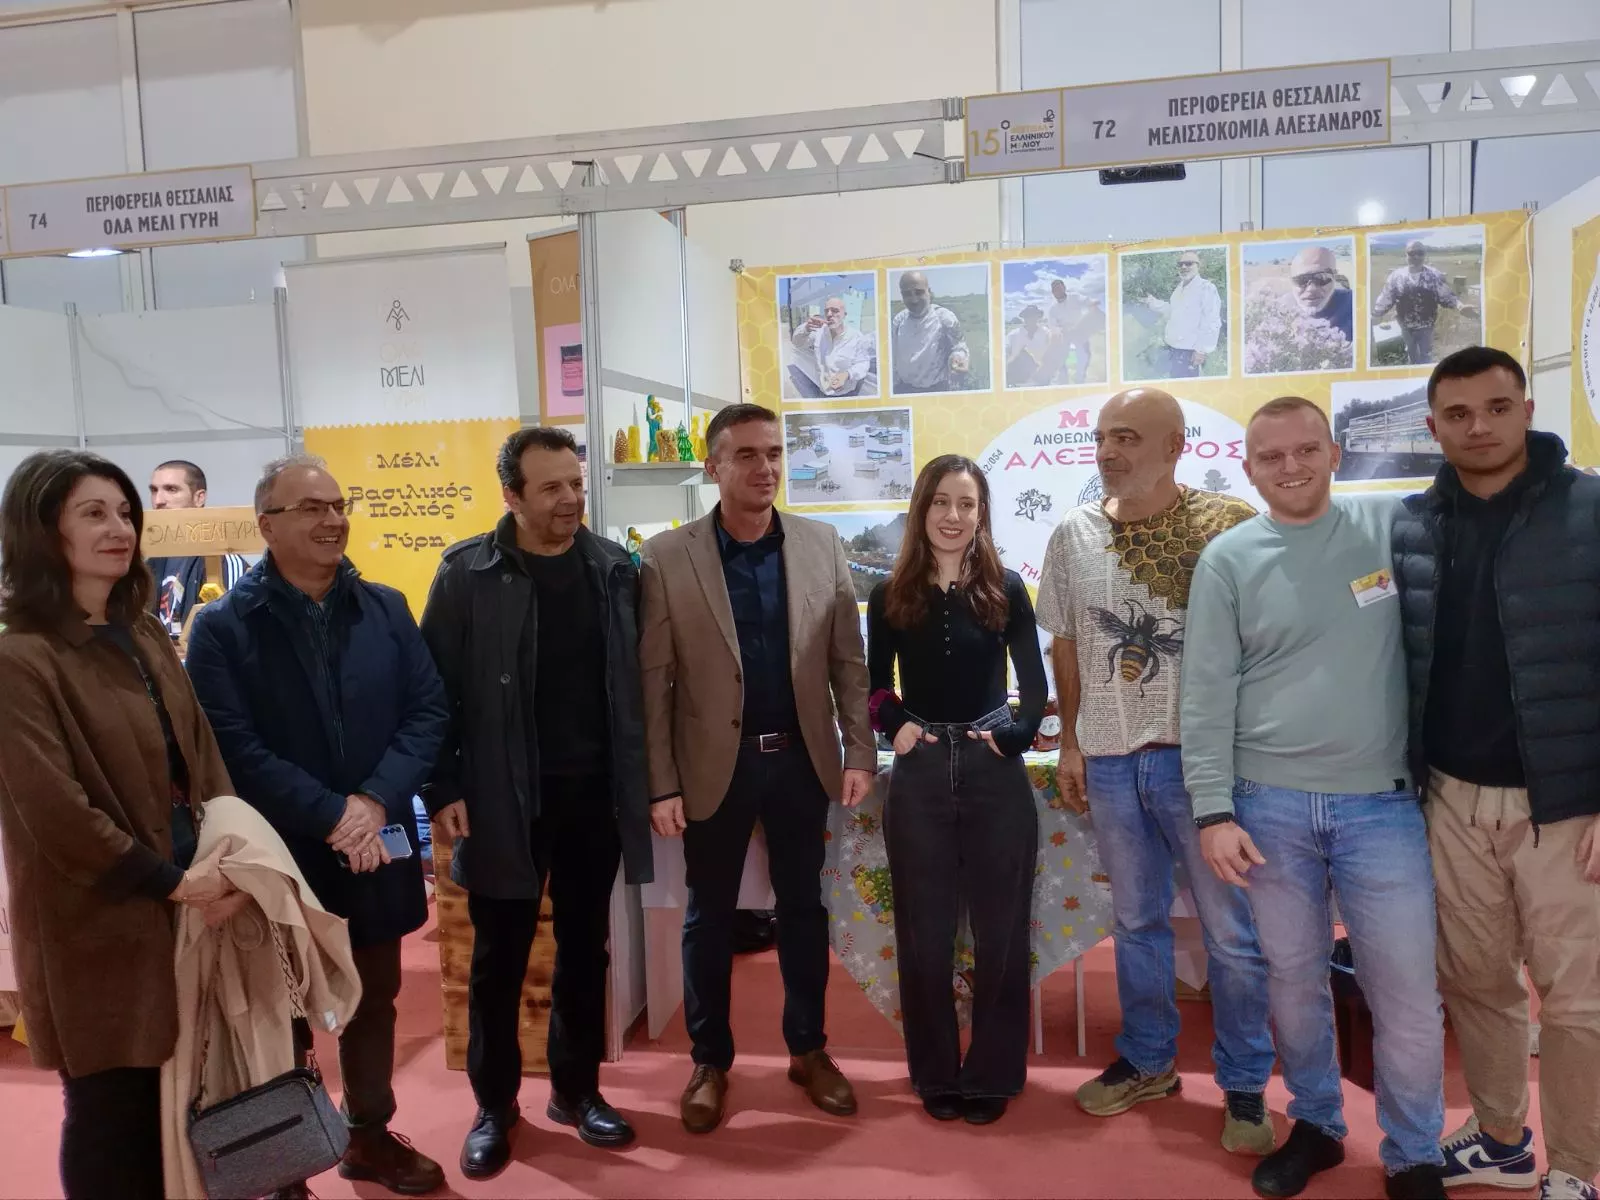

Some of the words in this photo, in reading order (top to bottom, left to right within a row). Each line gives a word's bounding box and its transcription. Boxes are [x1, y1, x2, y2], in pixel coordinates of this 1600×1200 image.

[1168, 90, 1267, 118] ΠΕΡΙΦΕΡΕΙΑ
[1273, 82, 1361, 108] ΘΕΣΣΑΛΙΑΣ
[1010, 131, 1054, 142] ΕΛΛΗΝΙΚΟΥ
[1092, 120, 1116, 140] 72
[1148, 118, 1269, 146] ΜΕΛΙΣΣΟΚΟΜΙΑ
[1275, 109, 1383, 136] ΑΛΕΞΑΝΔΡΟΣ
[86, 192, 162, 213] ΠΕΡΙΦΕΡΕΙΑ
[166, 185, 234, 206] ΘΕΣΣΑΛΙΑΣ
[29, 213, 48, 230] 74
[103, 218, 133, 235] ΟΛΑ
[138, 214, 175, 233] ΜΕΛΙ
[180, 211, 219, 229] ΓΥΡΗ
[380, 364, 424, 388] ΜΕΛΙ
[377, 452, 440, 469] Μέλι
[348, 482, 473, 501] Βασιλικός
[369, 501, 455, 520] Πολτός
[383, 532, 446, 552] Γύρη
